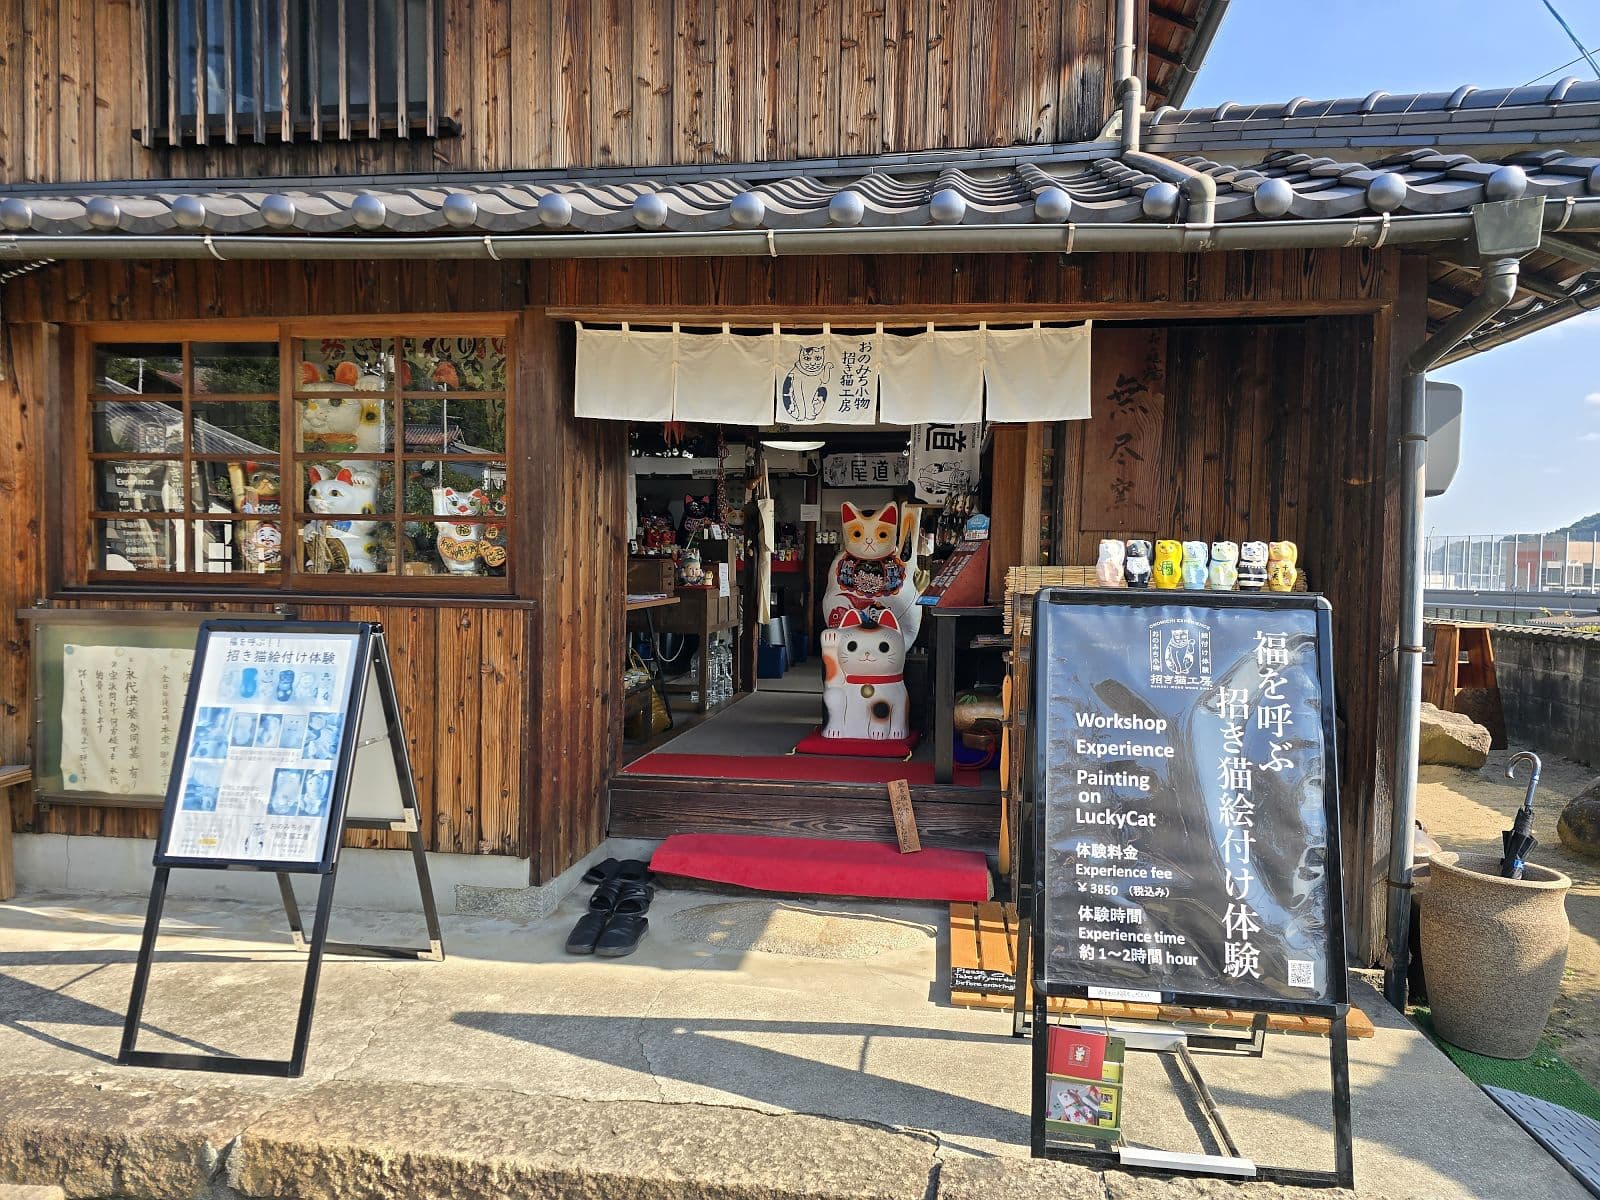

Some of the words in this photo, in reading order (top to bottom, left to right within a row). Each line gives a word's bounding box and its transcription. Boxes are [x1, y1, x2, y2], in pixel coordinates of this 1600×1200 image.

[838, 351, 856, 413] 招き猫工房
[854, 341, 873, 410] おのみち小物
[851, 460, 888, 482] 尾道
[226, 649, 336, 665] 招き猫絵付け体験
[1150, 673, 1213, 687] 招き猫工房
[1253, 630, 1295, 772] 福を呼ぶ
[1076, 712, 1167, 734] Workshop
[1076, 738, 1175, 758] Experience
[1077, 769, 1150, 791] Painting
[1078, 790, 1101, 803] on
[1076, 808, 1156, 829] LuckyCat
[1215, 686, 1262, 981] 招き猫絵付け体験
[1075, 843, 1139, 860] 体験料金
[1075, 864, 1147, 878] Experience
[1150, 867, 1173, 880] fee
[1078, 905, 1142, 924] 体験時間
[1078, 927, 1152, 942] Experience
[1154, 931, 1186, 945] time
[1165, 951, 1199, 966] hour
